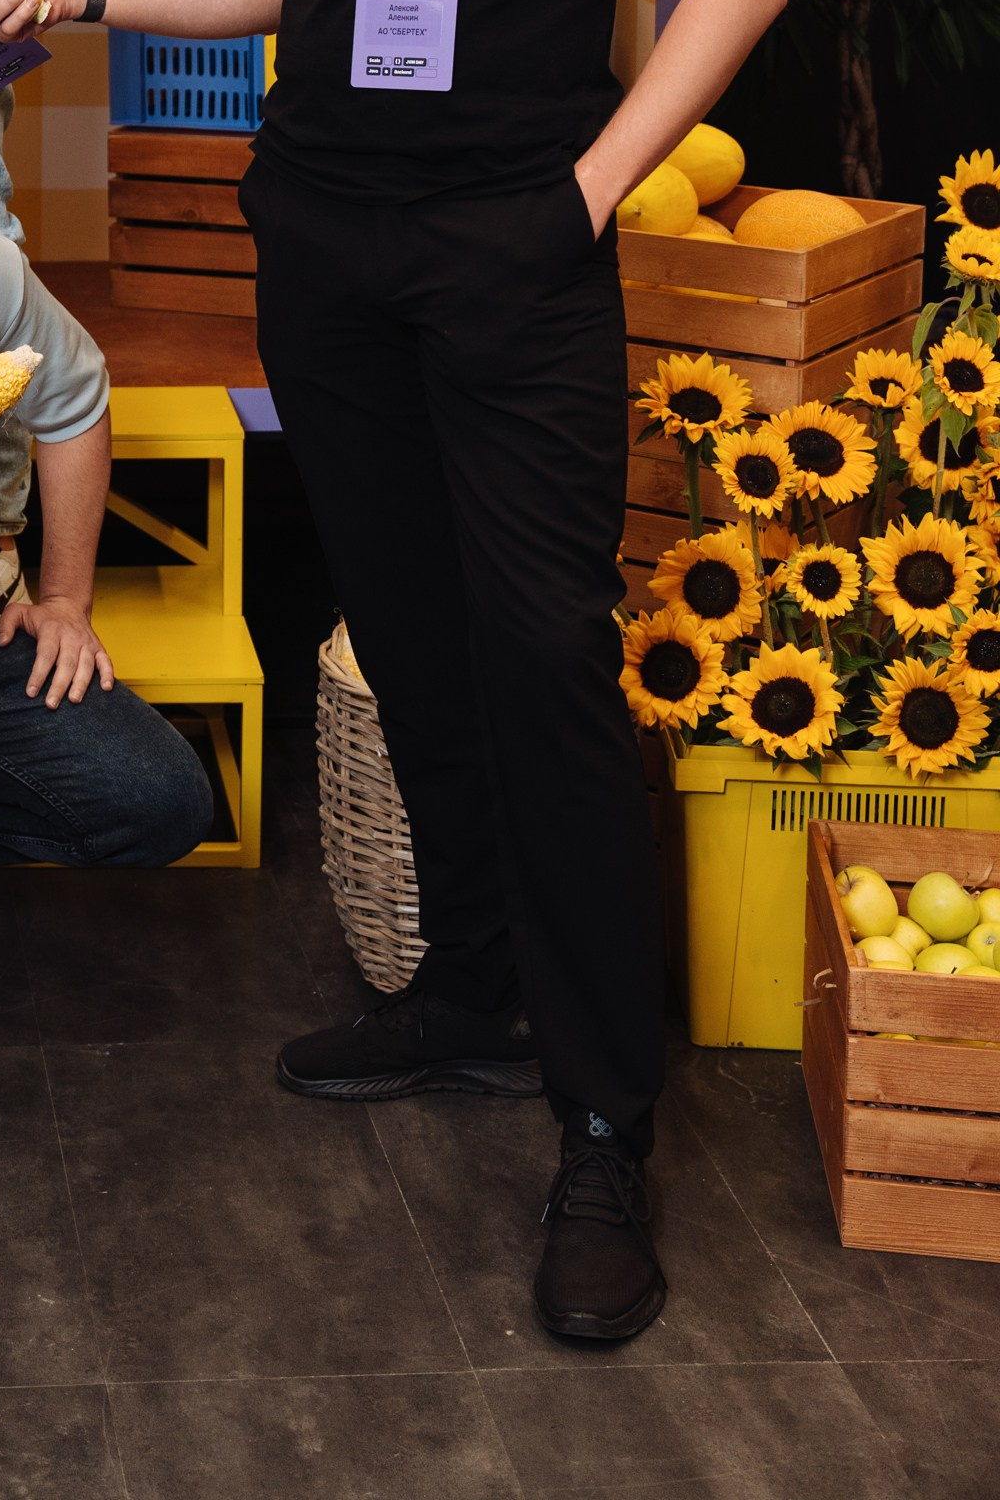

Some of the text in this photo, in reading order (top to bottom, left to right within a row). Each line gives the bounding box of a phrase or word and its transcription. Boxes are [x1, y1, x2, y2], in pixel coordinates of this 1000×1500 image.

[388, 4, 419, 12] Алексей
[388, 13, 419, 21] Аленкин
[377, 27, 389, 36] АО
